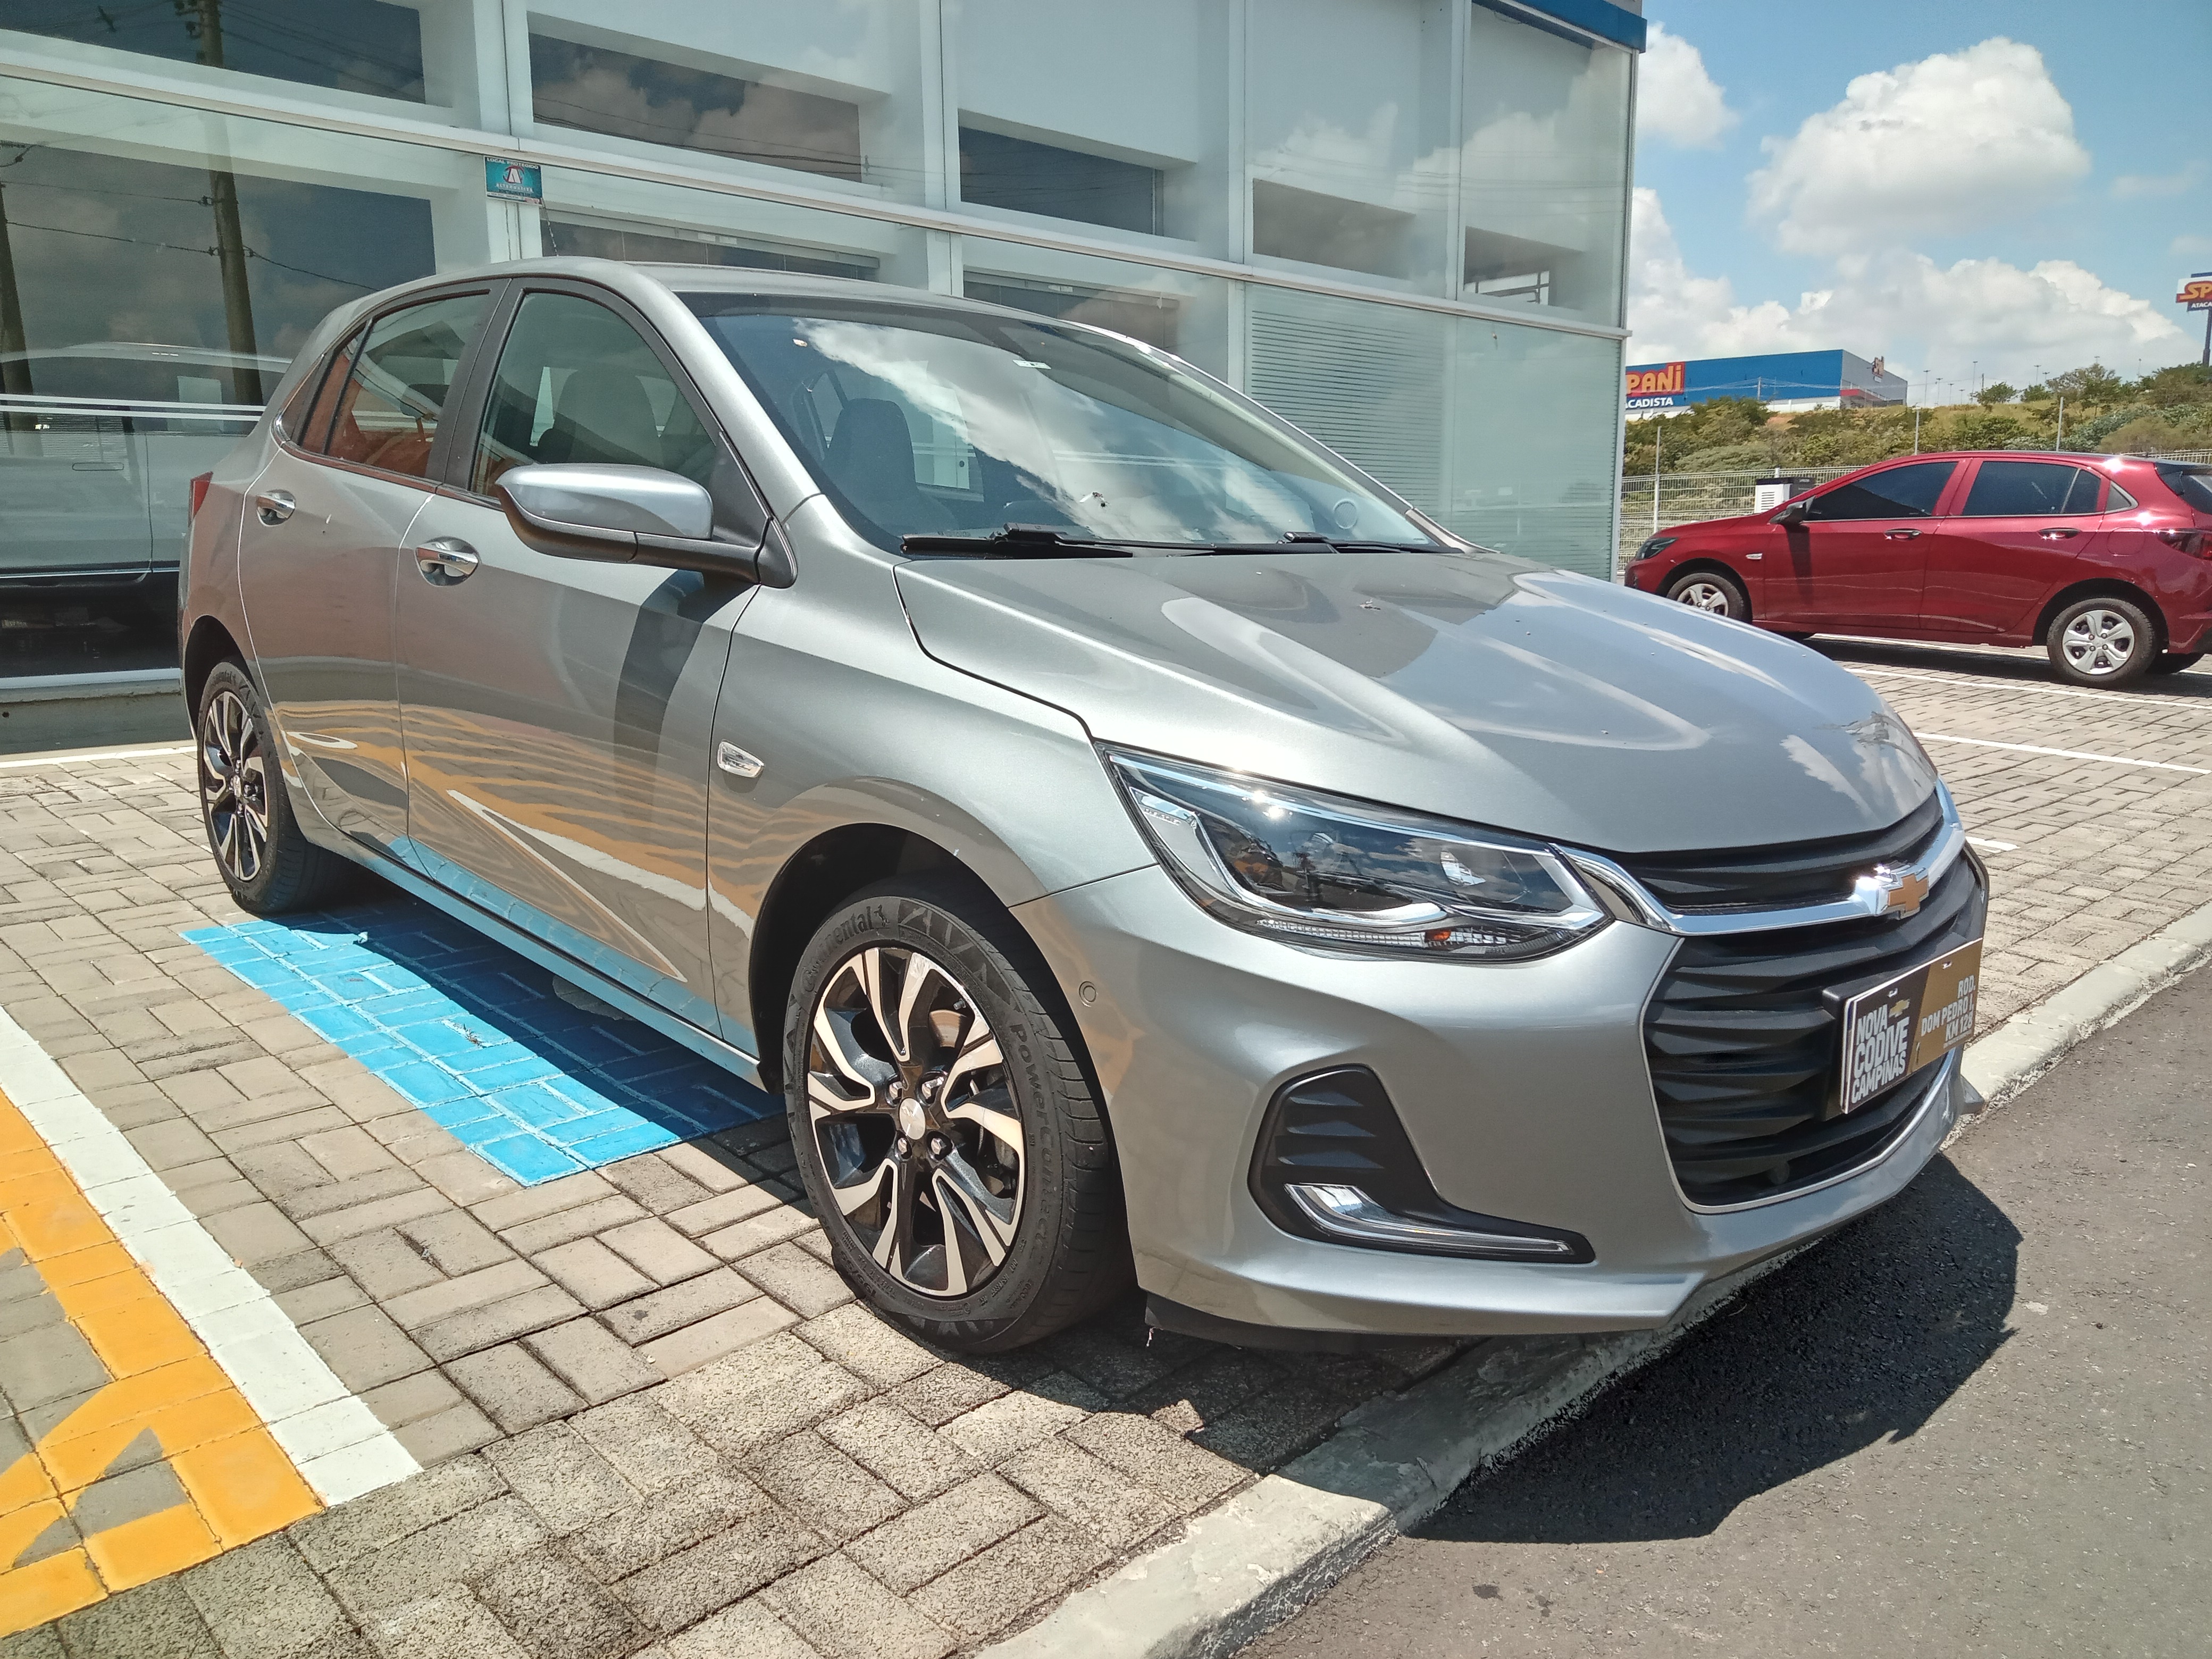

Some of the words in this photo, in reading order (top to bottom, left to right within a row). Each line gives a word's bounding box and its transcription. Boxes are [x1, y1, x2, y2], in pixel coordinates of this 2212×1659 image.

[1957, 975, 1976, 999] ROD.
[1856, 1003, 1888, 1045] NOVA
[1921, 1010, 1941, 1037] DOM
[1941, 996, 1968, 1026] PEDRO
[1946, 1018, 1958, 1042] KM
[1959, 1010, 1973, 1034] 128
[1854, 1016, 1910, 1079] CODIVE
[1851, 1050, 1906, 1104] CAMPINAS
